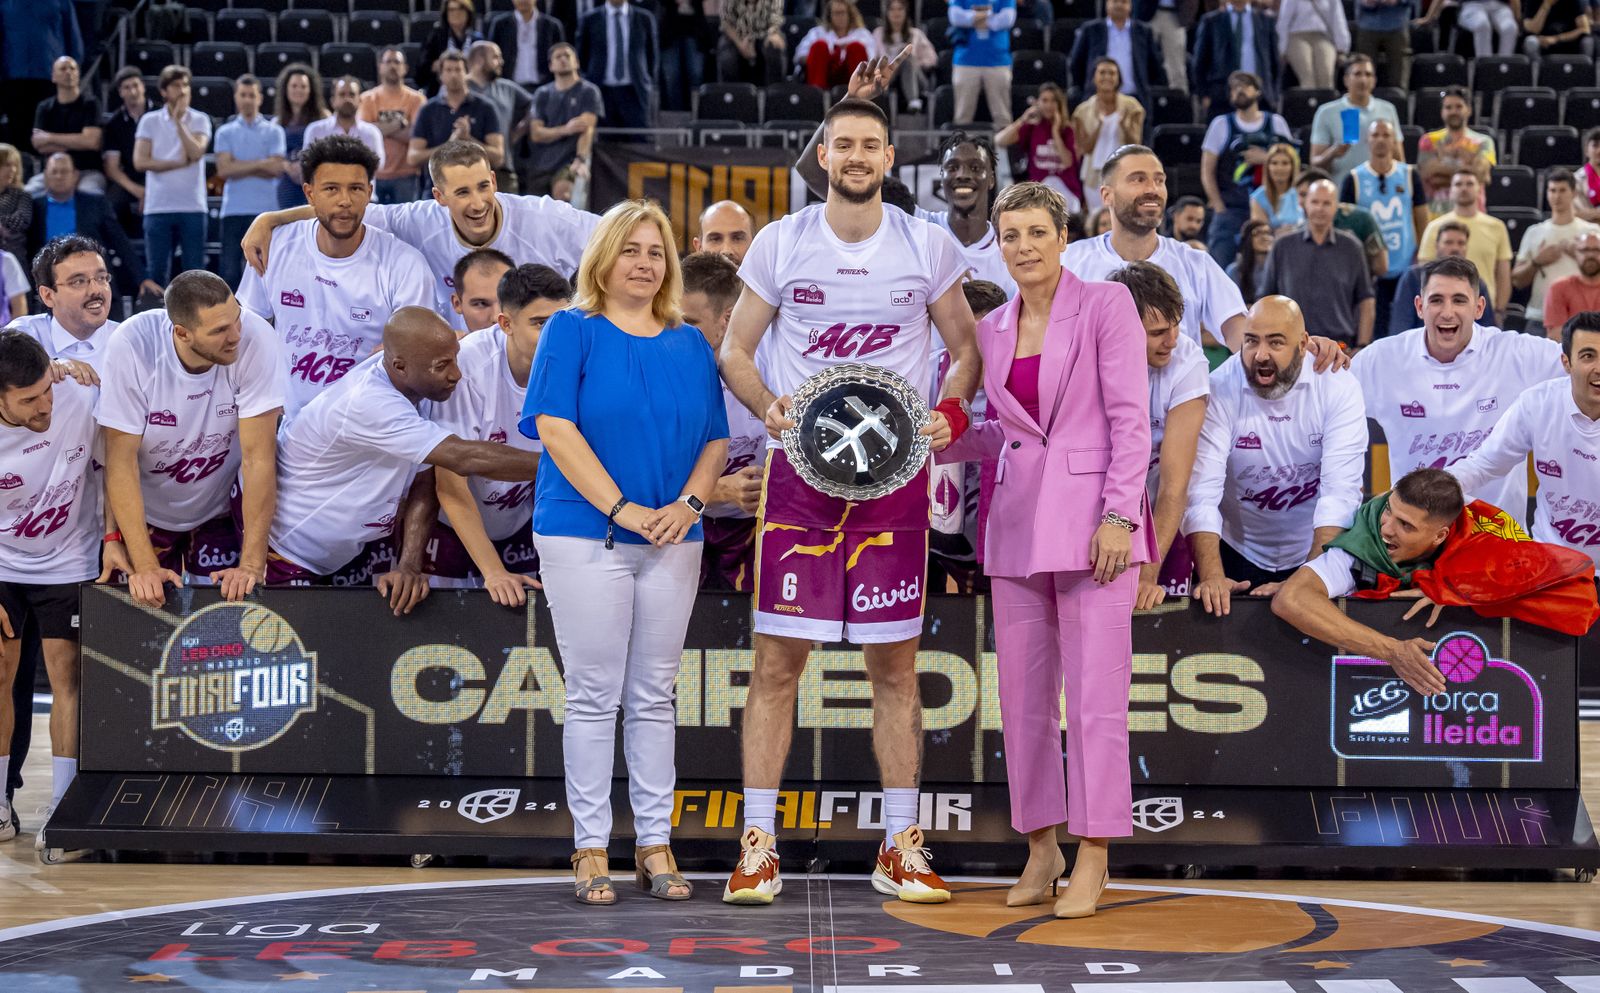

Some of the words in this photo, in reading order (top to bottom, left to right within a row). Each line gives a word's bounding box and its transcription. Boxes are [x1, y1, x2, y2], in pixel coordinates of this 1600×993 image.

[893, 294, 910, 304] acb
[352, 312, 366, 320] acb
[802, 323, 900, 358] ACB
[291, 352, 356, 386] ACB
[218, 408, 234, 416] acb
[149, 449, 230, 484] ACB
[1240, 478, 1320, 512] ACB
[0, 499, 74, 539] ACB
[426, 538, 439, 562] 4
[782, 572, 798, 601] 6
[181, 646, 209, 662] LEB
[390, 643, 1269, 735] CAPEOES
[1349, 733, 1410, 744] Software
[1423, 713, 1523, 745] lleida
[1192, 810, 1226, 819] 24
[180, 921, 380, 939] Liga
[147, 939, 478, 961] LEB
[530, 935, 901, 957] ORO
